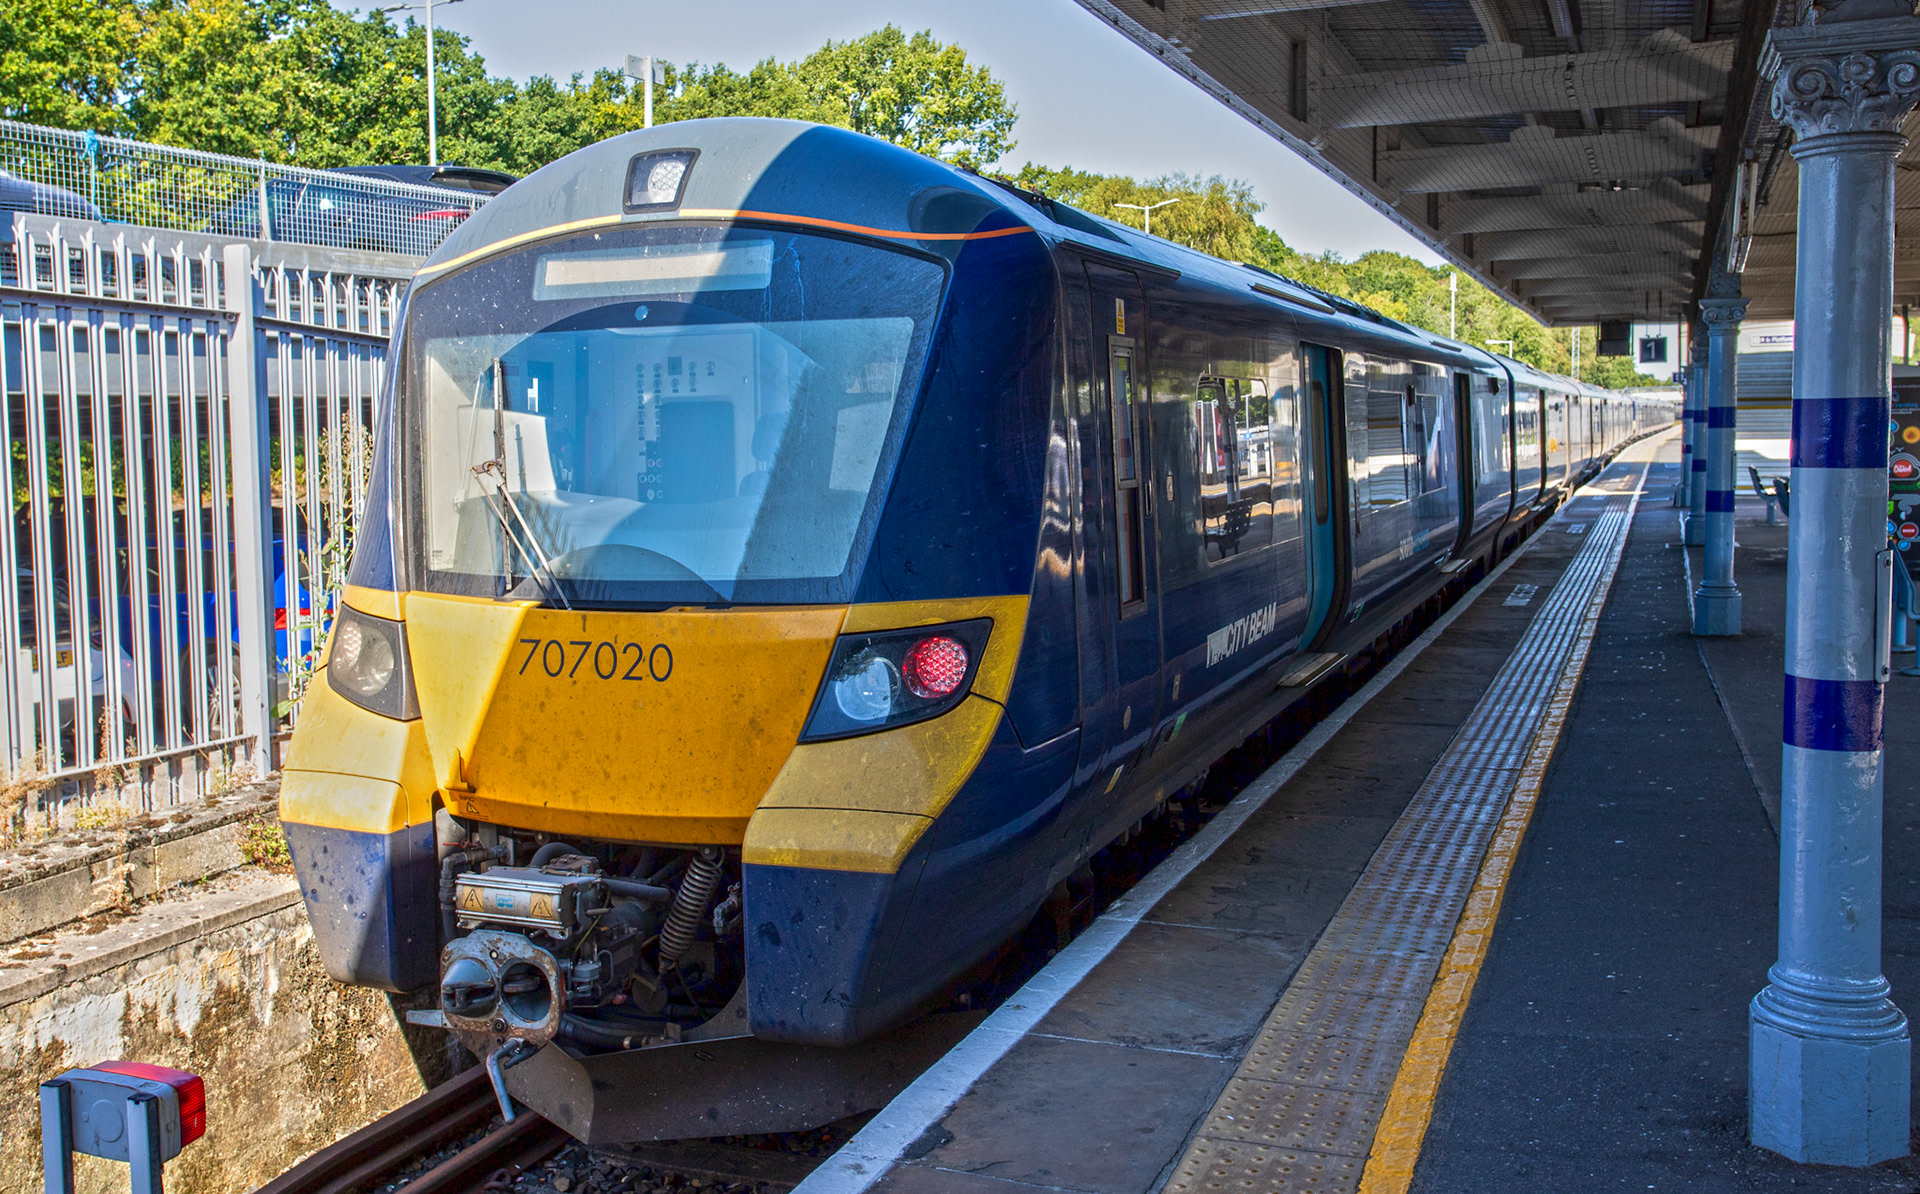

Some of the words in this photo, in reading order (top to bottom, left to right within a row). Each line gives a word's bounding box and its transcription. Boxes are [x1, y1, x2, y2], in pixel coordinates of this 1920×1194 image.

[1646, 341, 1656, 360] 1
[1225, 614, 1250, 658] CITY
[1247, 601, 1277, 646] BEAM
[518, 638, 674, 683] 707020
